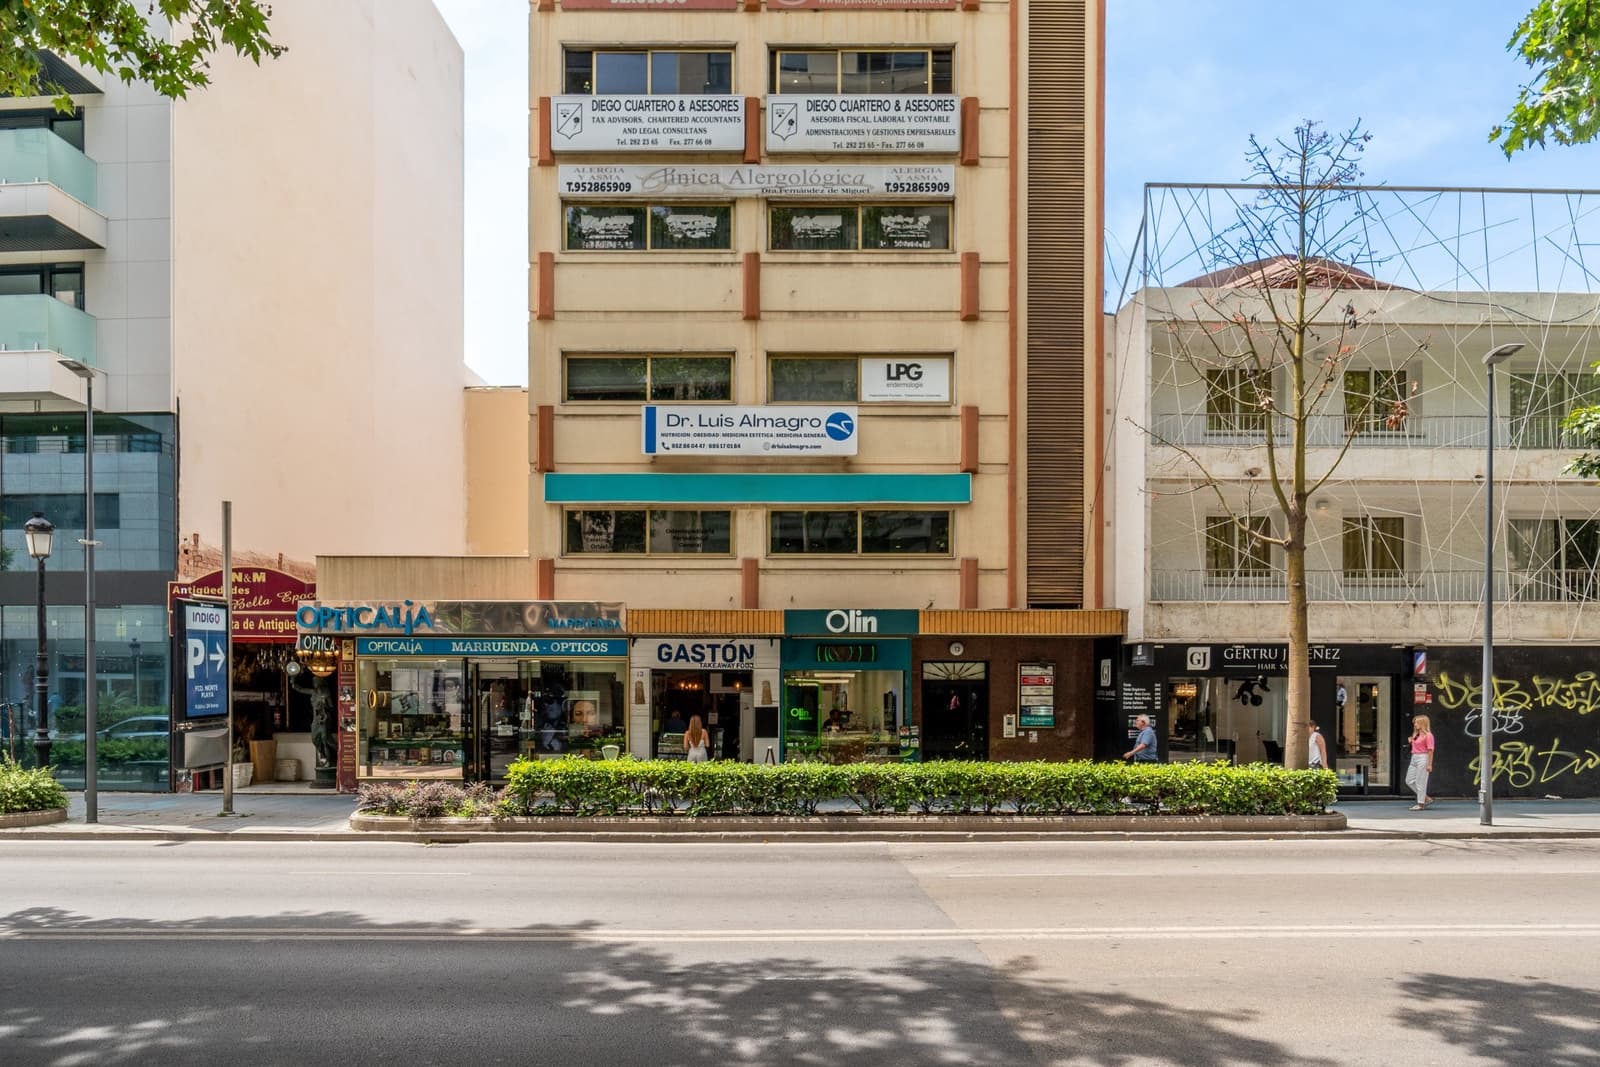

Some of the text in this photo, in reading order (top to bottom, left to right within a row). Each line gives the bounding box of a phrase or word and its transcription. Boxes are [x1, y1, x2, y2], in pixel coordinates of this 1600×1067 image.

[592, 100, 739, 112] DIEGO CUARTERO & ASESORES
[806, 100, 955, 112] DIEGO CUARTERO & ASESORES
[729, 168, 865, 189] Alergológica
[566, 182, 632, 192] T.952865909
[885, 182, 950, 193] T.952865909
[886, 363, 923, 381] LPG
[666, 414, 822, 431] Dr. Luis Almagro
[232, 572, 266, 583] N&M
[172, 585, 250, 595] Antigüeddes
[192, 612, 220, 624] INDIGO
[826, 610, 877, 633] Olin
[243, 618, 254, 630] de
[258, 618, 297, 633] Antigüe
[304, 636, 335, 650] OPTICA
[452, 642, 539, 652] MARRUENDA
[551, 642, 608, 652] OPTICOS
[657, 639, 754, 663] GASTÓN
[1224, 648, 1341, 661] GERTRU JENEZ
[187, 638, 204, 679] P
[1189, 651, 1208, 668] GJ
[790, 708, 809, 717] Olin
